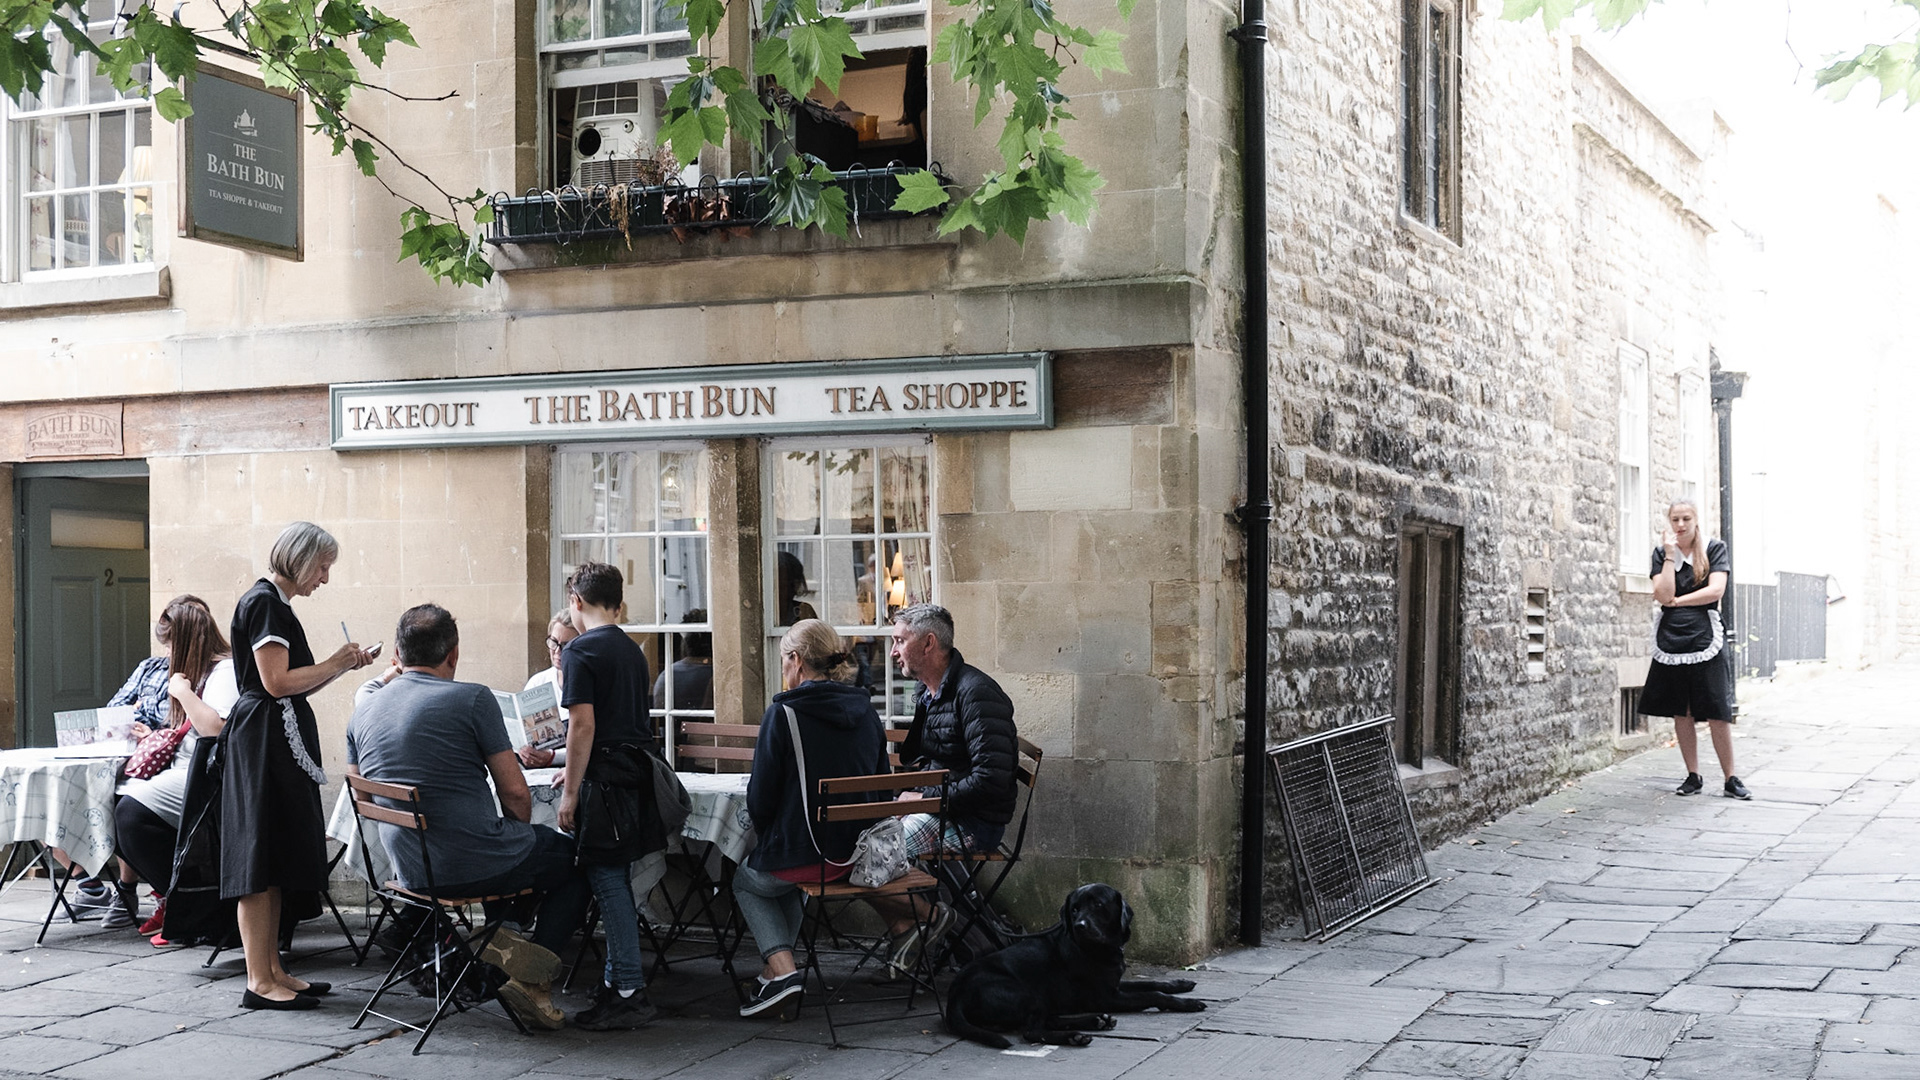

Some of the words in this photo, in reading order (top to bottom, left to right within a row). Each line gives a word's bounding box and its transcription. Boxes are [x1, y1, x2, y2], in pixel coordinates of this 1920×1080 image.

[233, 143, 257, 162] THE
[207, 153, 250, 182] BATH
[254, 166, 285, 191] BUN
[208, 188, 222, 199] TEA
[222, 192, 247, 206] SHOPPE
[247, 198, 253, 207] &
[254, 200, 284, 215] TAKEOUT
[348, 401, 479, 431] TAKEOUT
[523, 394, 592, 425] THE
[597, 389, 695, 422] BATH
[699, 384, 777, 418] BUN
[824, 386, 893, 414] TEA
[902, 380, 1028, 412] SHOPPE
[28, 415, 74, 442] BATH
[79, 415, 118, 440] BUN
[104, 568, 114, 587] 2
